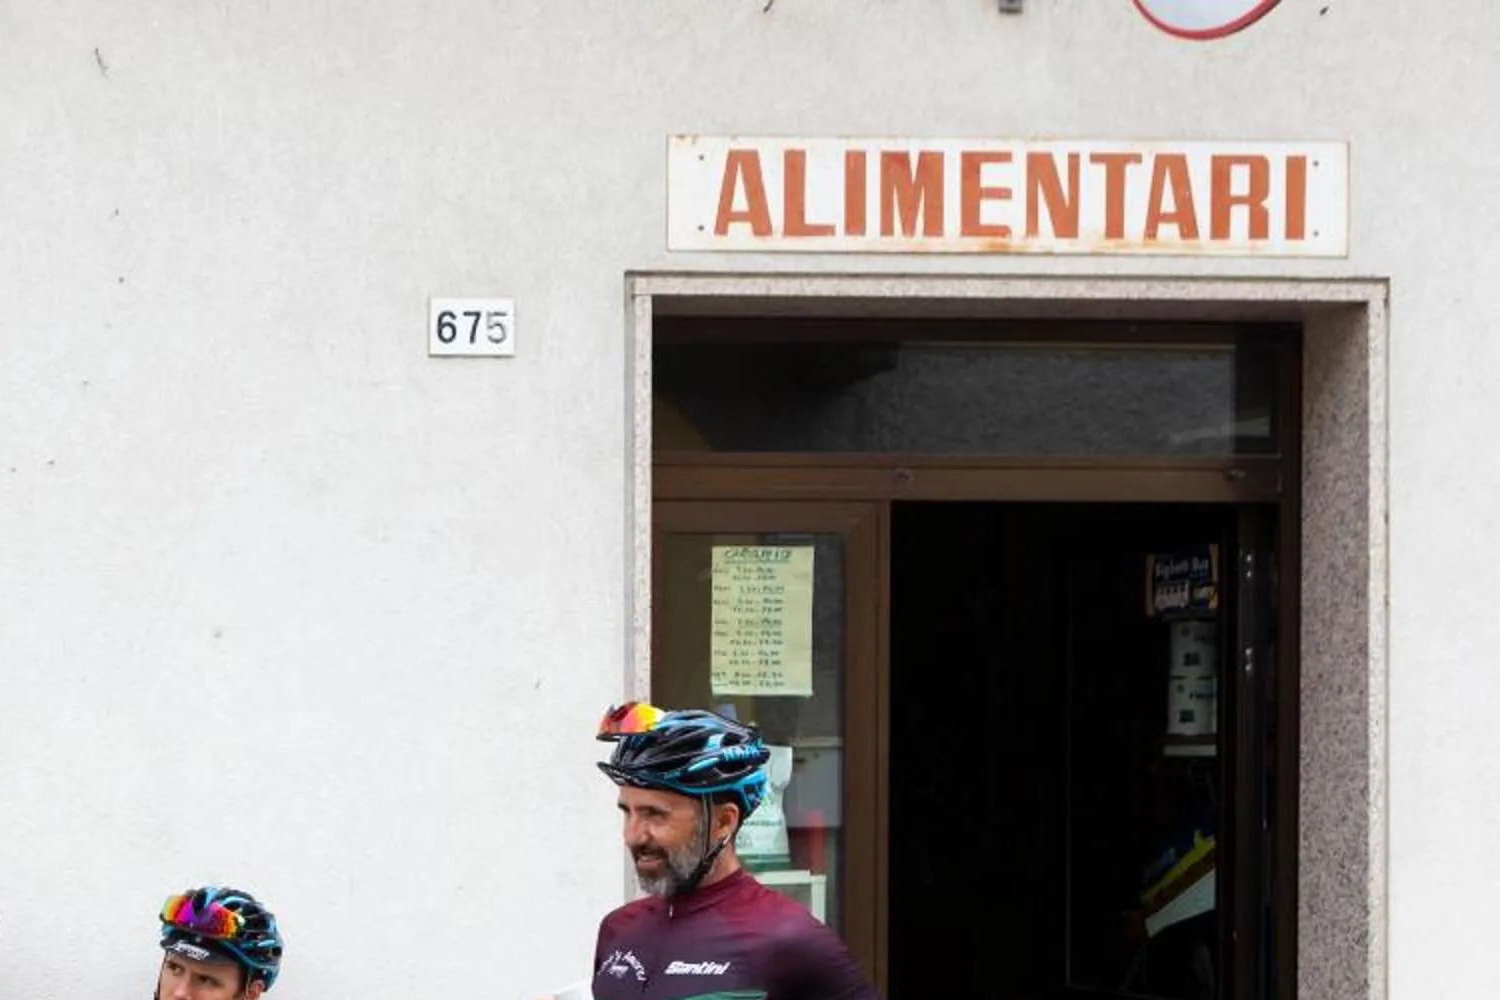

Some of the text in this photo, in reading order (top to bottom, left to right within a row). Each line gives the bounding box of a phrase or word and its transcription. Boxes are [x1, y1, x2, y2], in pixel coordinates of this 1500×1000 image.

[713, 149, 1308, 241] ALIMENTARI
[437, 310, 508, 344] 675
[664, 961, 731, 975] Santini
